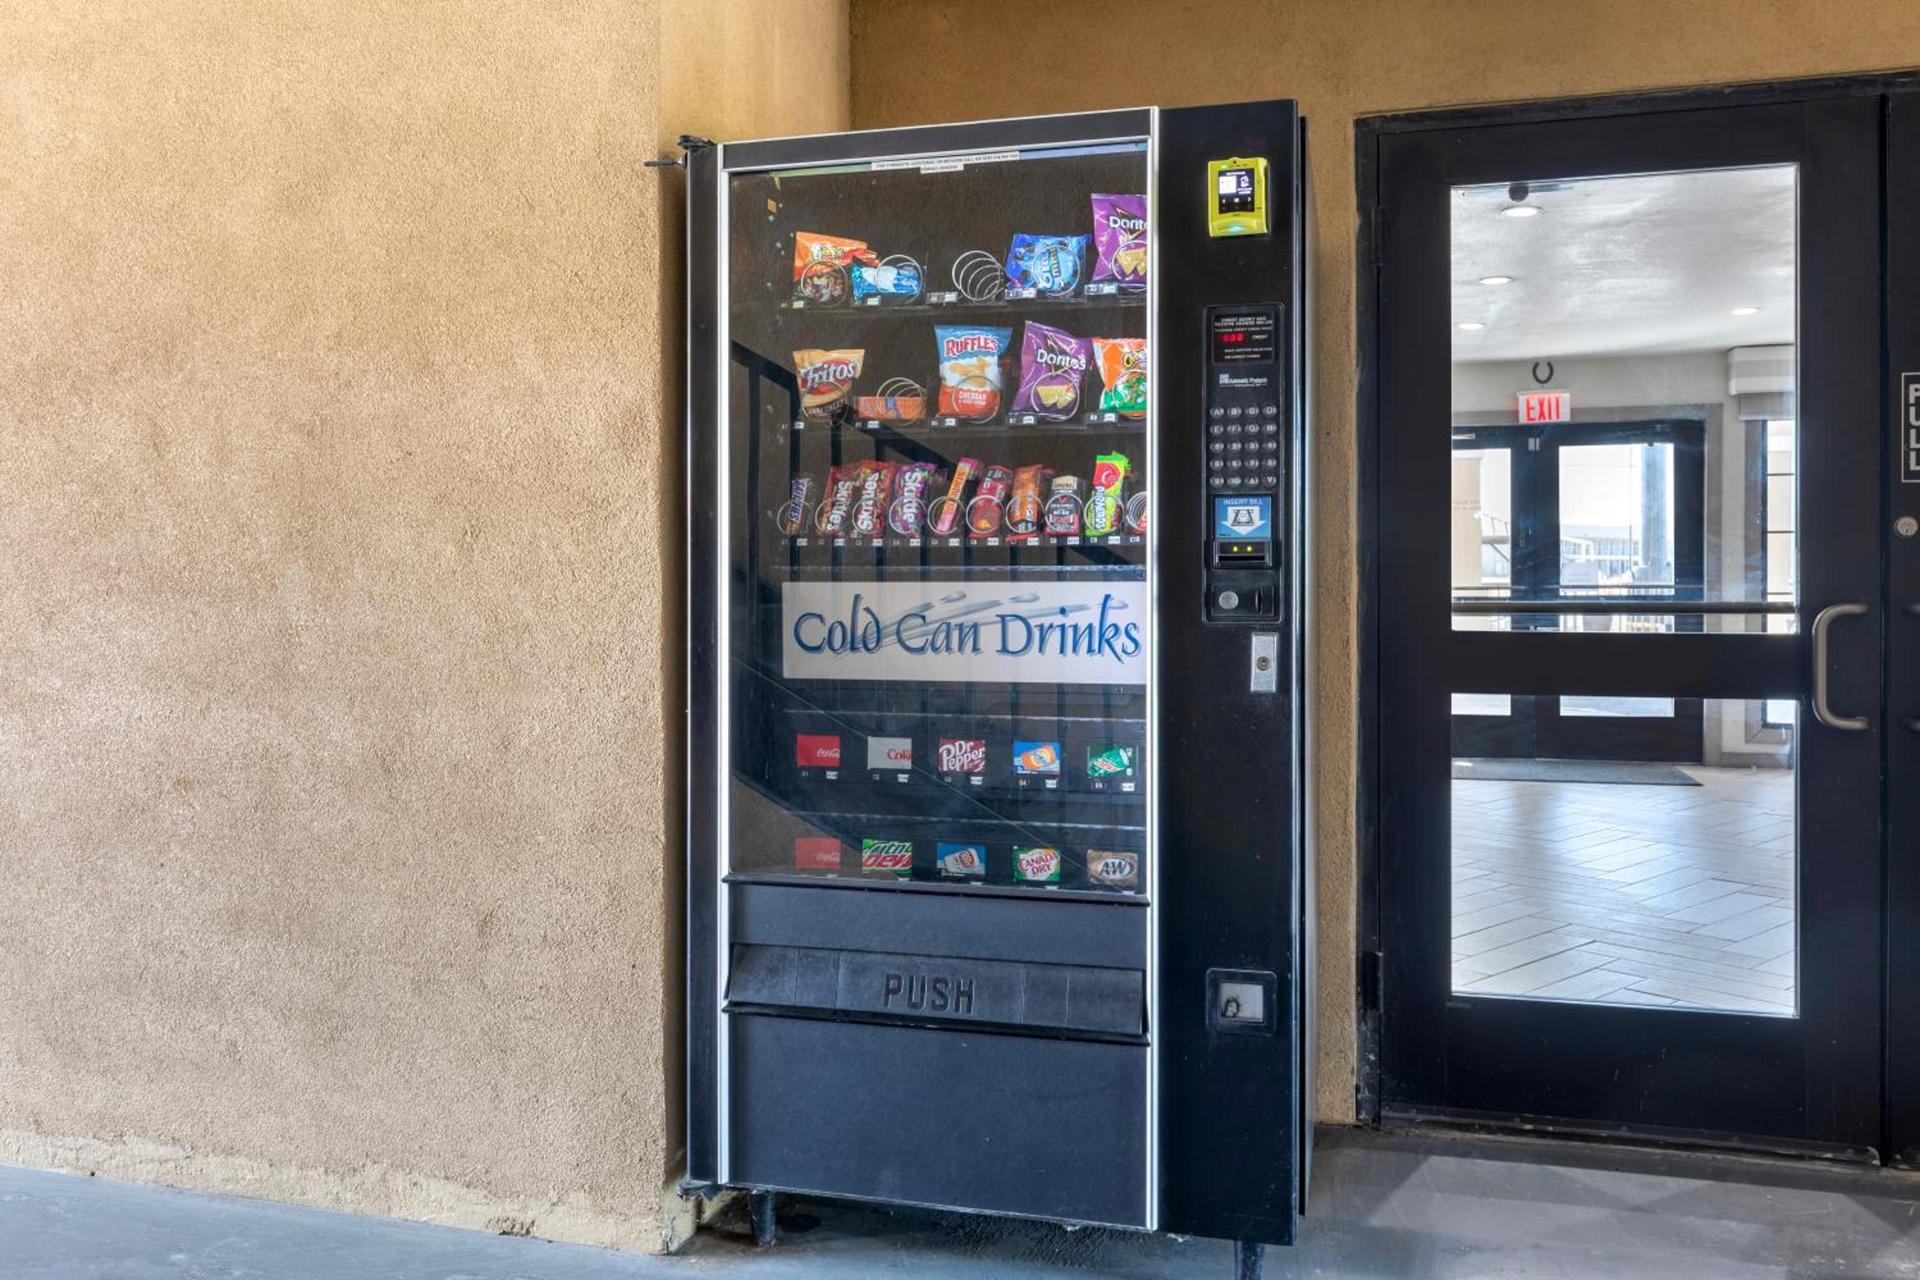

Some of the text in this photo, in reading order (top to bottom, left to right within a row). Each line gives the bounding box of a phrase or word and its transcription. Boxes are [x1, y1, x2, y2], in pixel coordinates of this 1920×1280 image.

[944, 334, 999, 358] RUFFLES
[1036, 348, 1087, 371] Doritos
[800, 360, 857, 392] Fritos
[1526, 394, 1561, 423] EXIT
[793, 592, 1142, 664] Cold Can Drinks
[939, 744, 985, 772] Pepper
[955, 740, 974, 756] Dr
[1031, 863, 1053, 876] DRY
[884, 974, 975, 1015] PUSH
